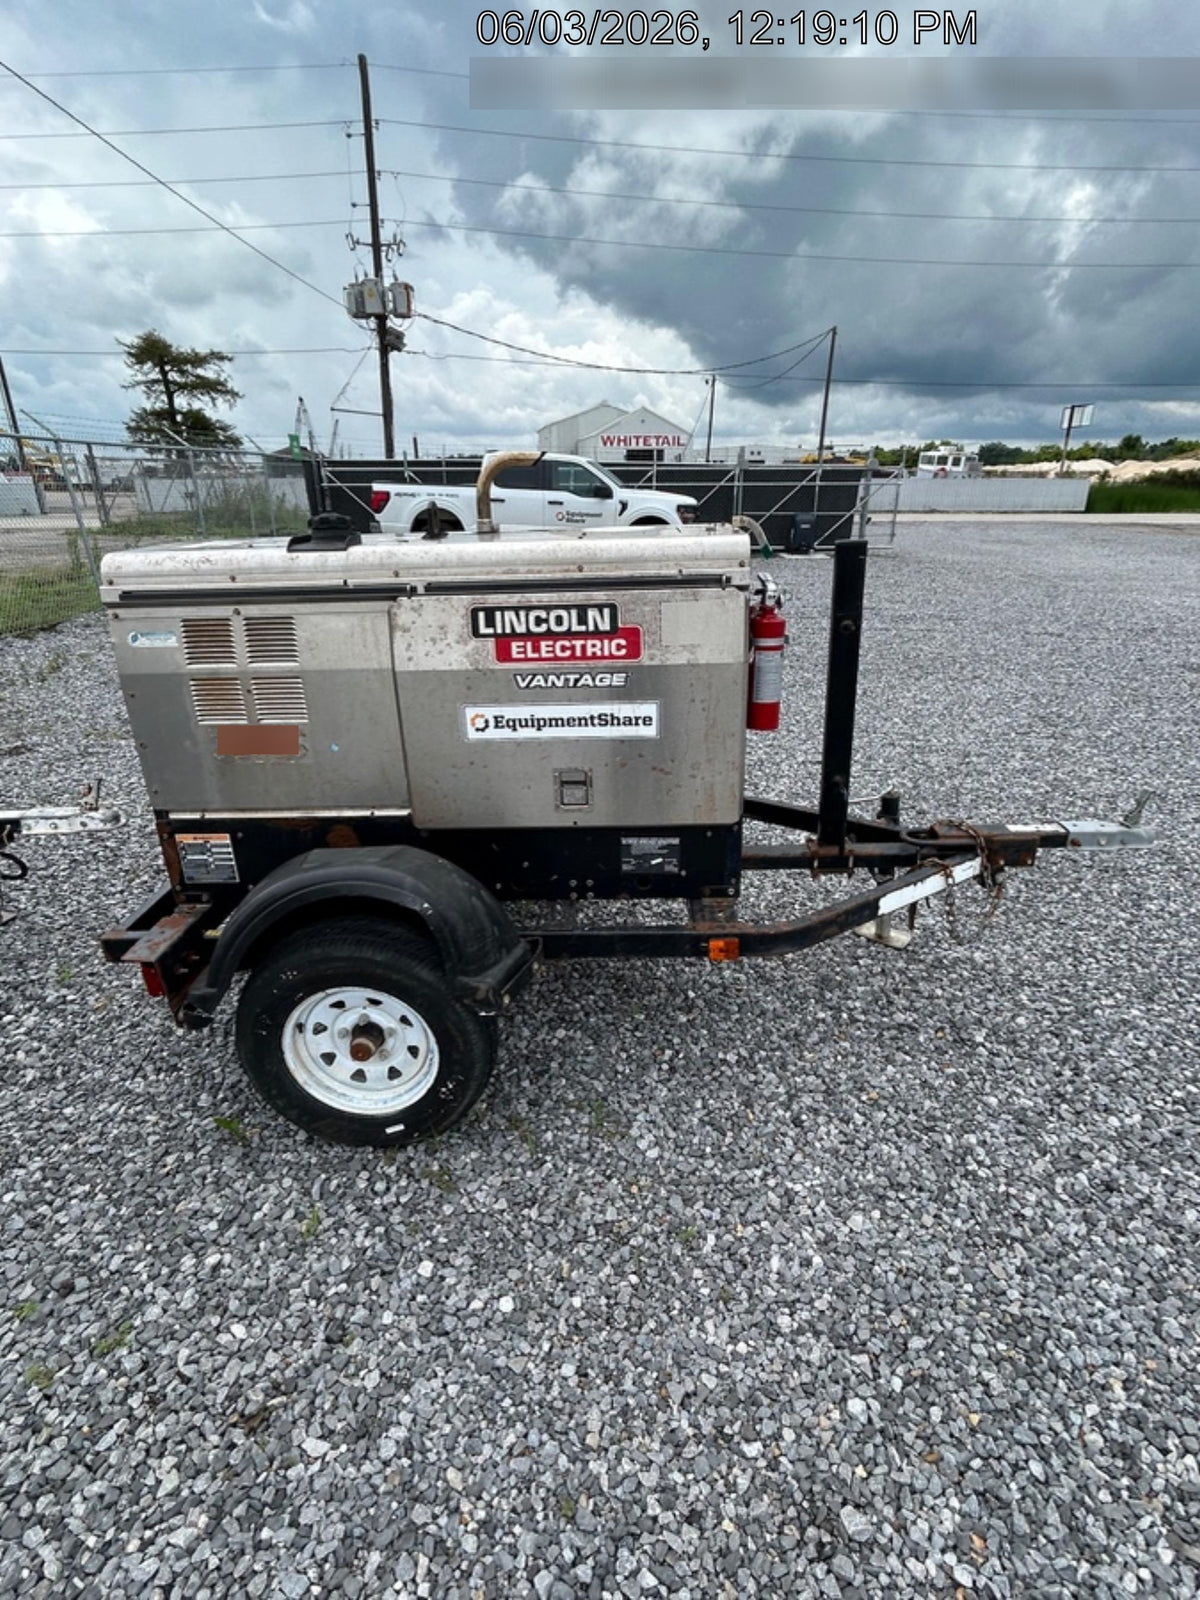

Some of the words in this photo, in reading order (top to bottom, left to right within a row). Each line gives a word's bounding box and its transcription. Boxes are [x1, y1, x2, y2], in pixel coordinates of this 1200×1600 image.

[600, 434, 685, 447] WHITETAIL
[477, 607, 611, 634] LINCOLN
[511, 638, 627, 659] ELECTRIC
[514, 672, 628, 688] VANTAGE
[493, 712, 653, 732] EquipmentShare
